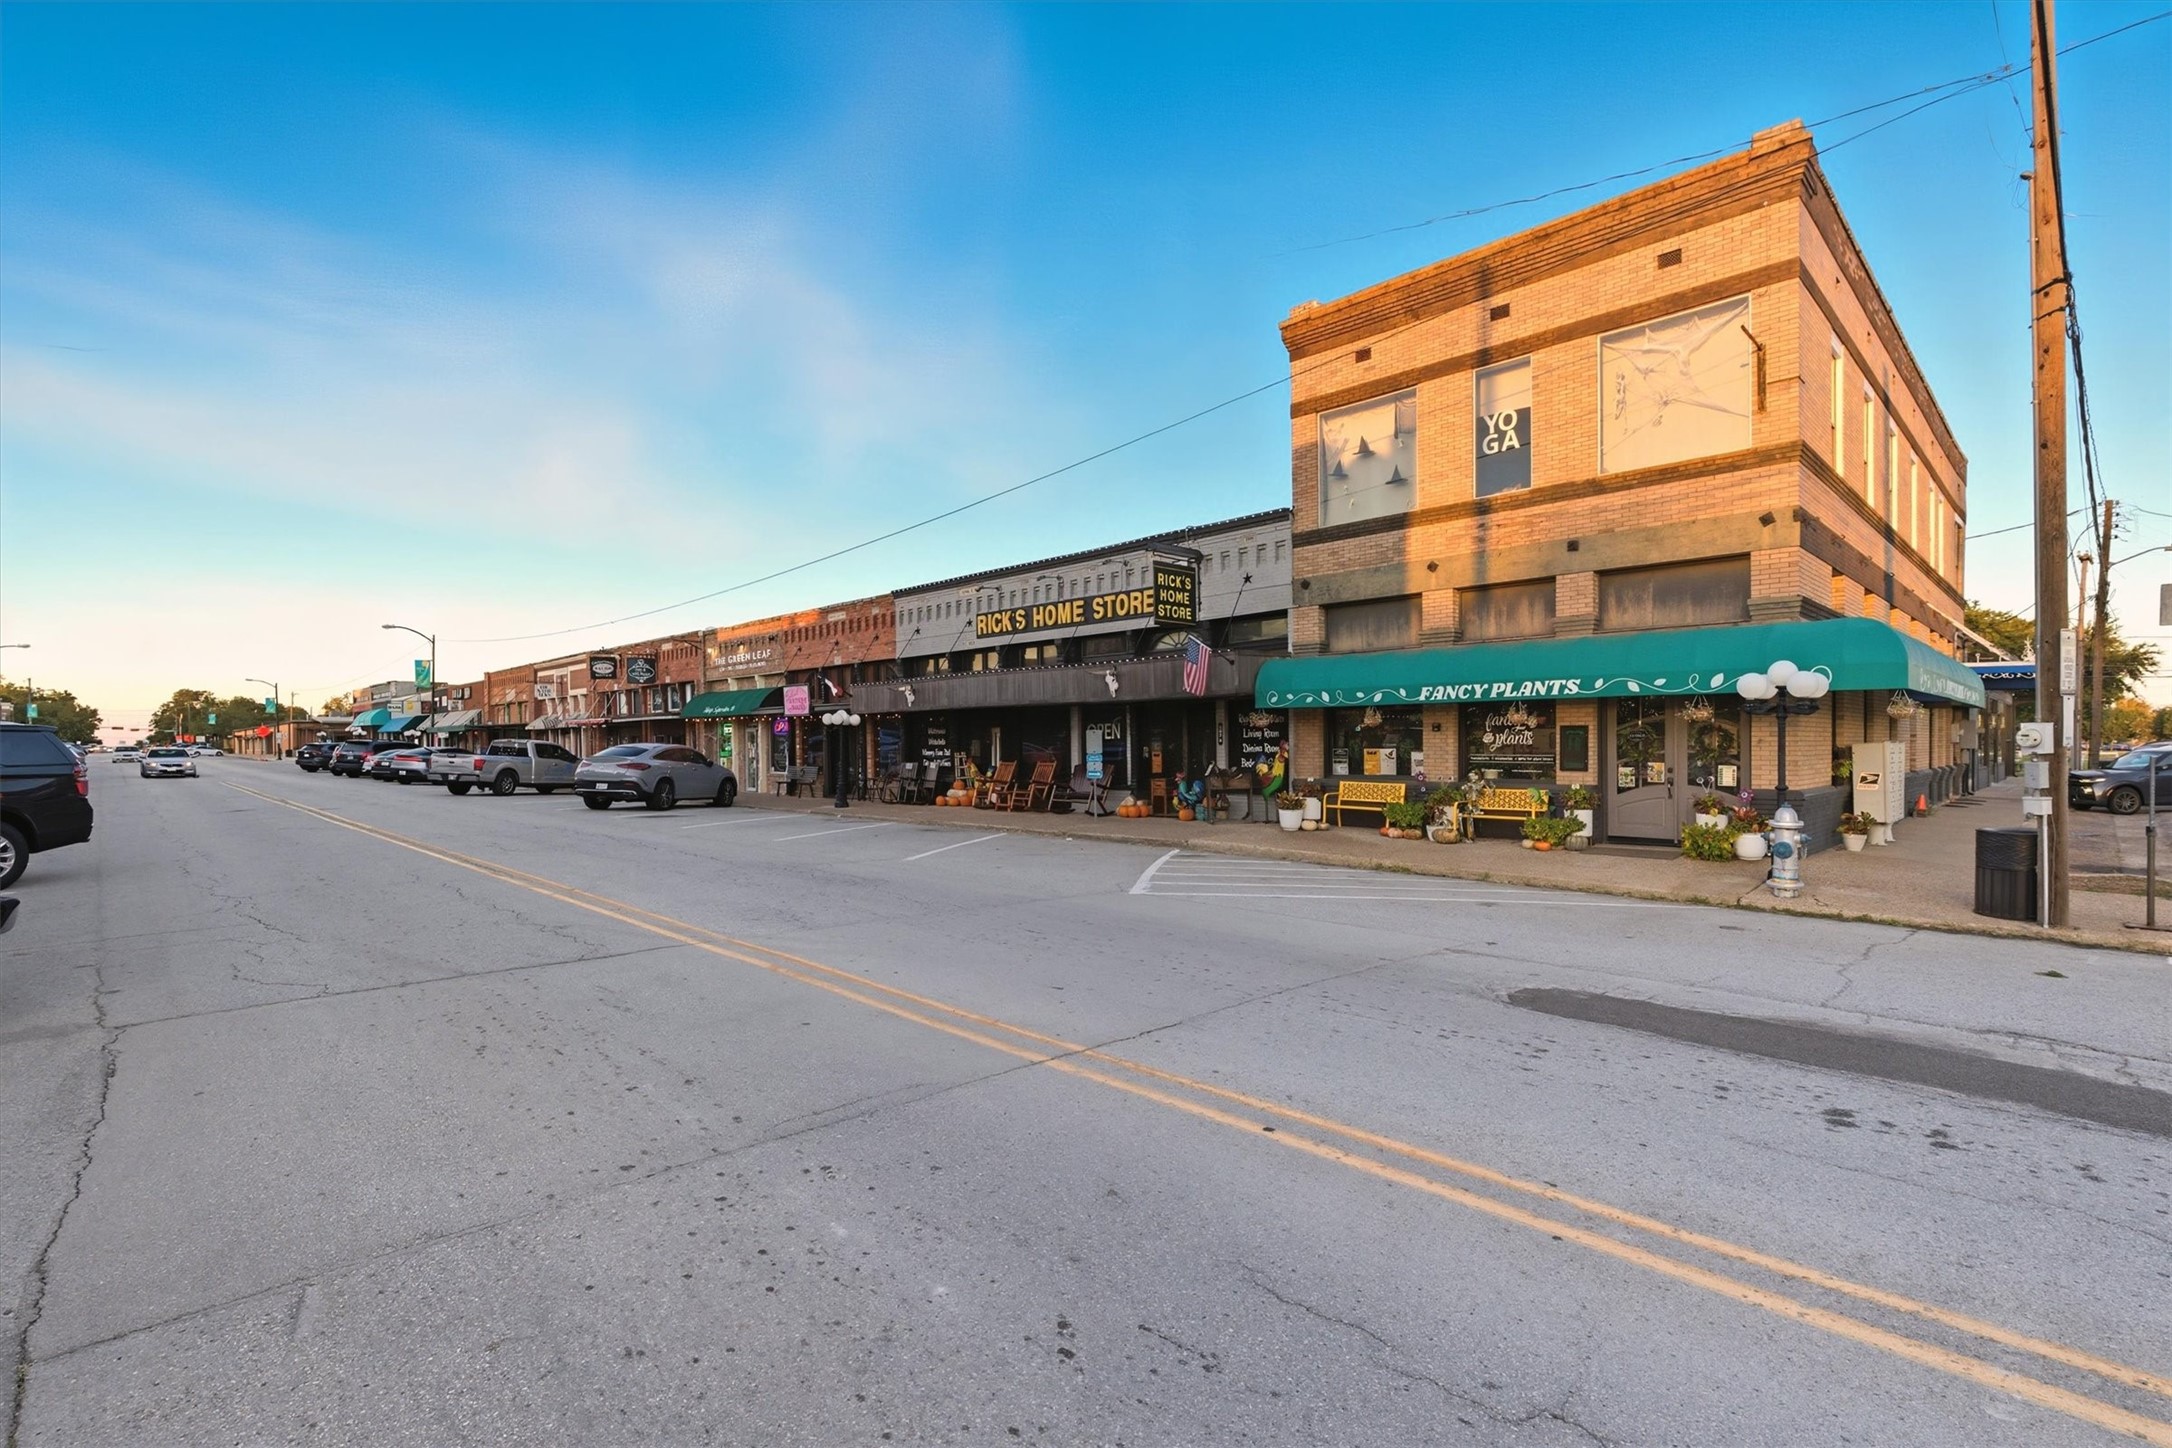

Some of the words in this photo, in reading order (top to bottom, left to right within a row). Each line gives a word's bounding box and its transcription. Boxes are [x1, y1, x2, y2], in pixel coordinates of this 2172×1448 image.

[1157, 572, 1192, 590] RICK'S
[1160, 588, 1190, 604] HOME
[977, 609, 1026, 636] RICK'S
[1033, 600, 1085, 629] HOME
[1092, 588, 1154, 621] STORE
[1157, 604, 1192, 620] STORE
[715, 656, 726, 666] THE
[727, 652, 751, 664] GREEN
[752, 648, 772, 660] LEAF
[1418, 683, 1488, 701] FANCY
[1489, 678, 1582, 698] PLANTS
[1243, 728, 1262, 740] Living
[1263, 728, 1280, 739] Room
[1489, 728, 1534, 752] plants
